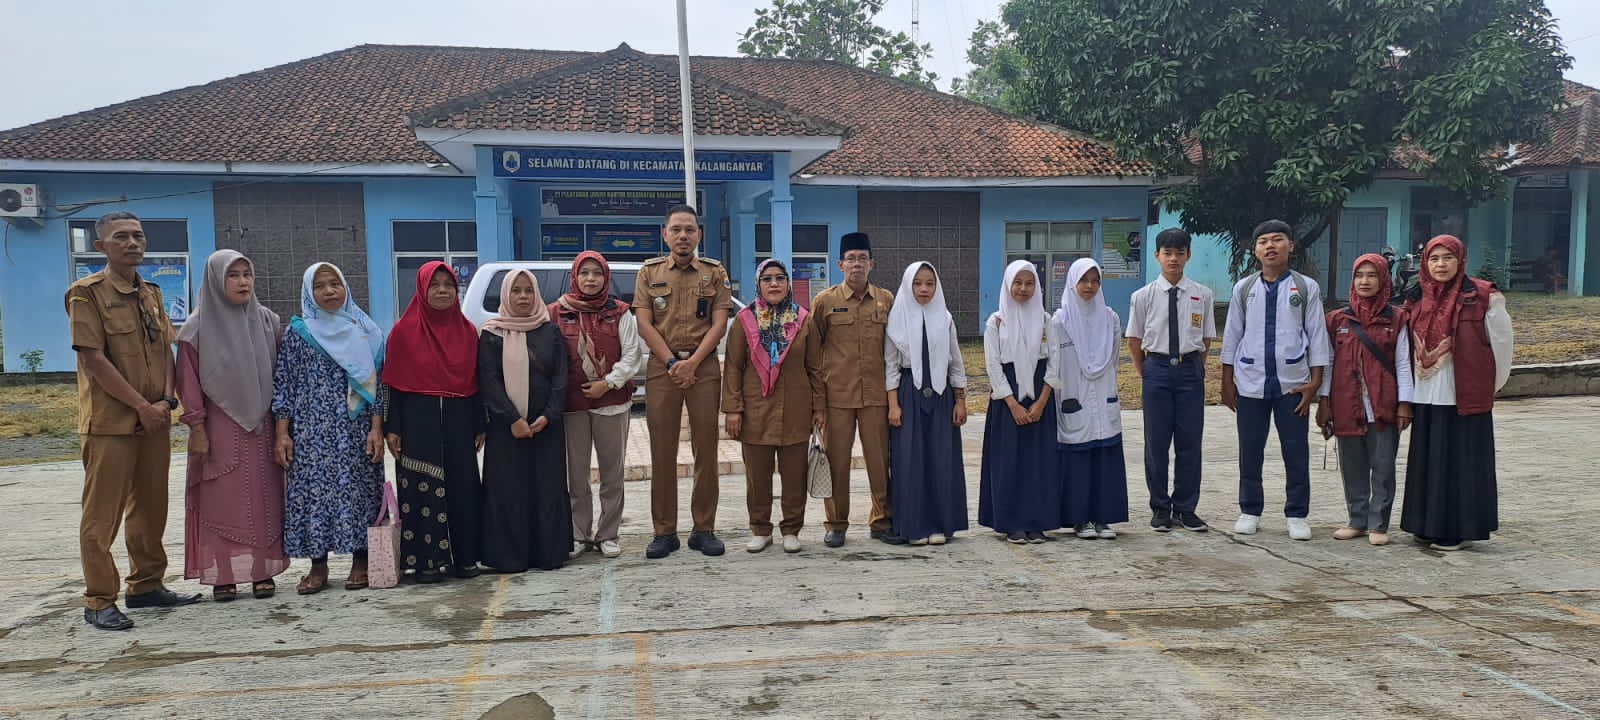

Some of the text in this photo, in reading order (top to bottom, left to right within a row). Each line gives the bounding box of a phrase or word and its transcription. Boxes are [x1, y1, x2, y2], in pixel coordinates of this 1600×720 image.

[527, 158, 764, 172] SELAMAT DATANG DI KECAMATA KALANGANYAR
